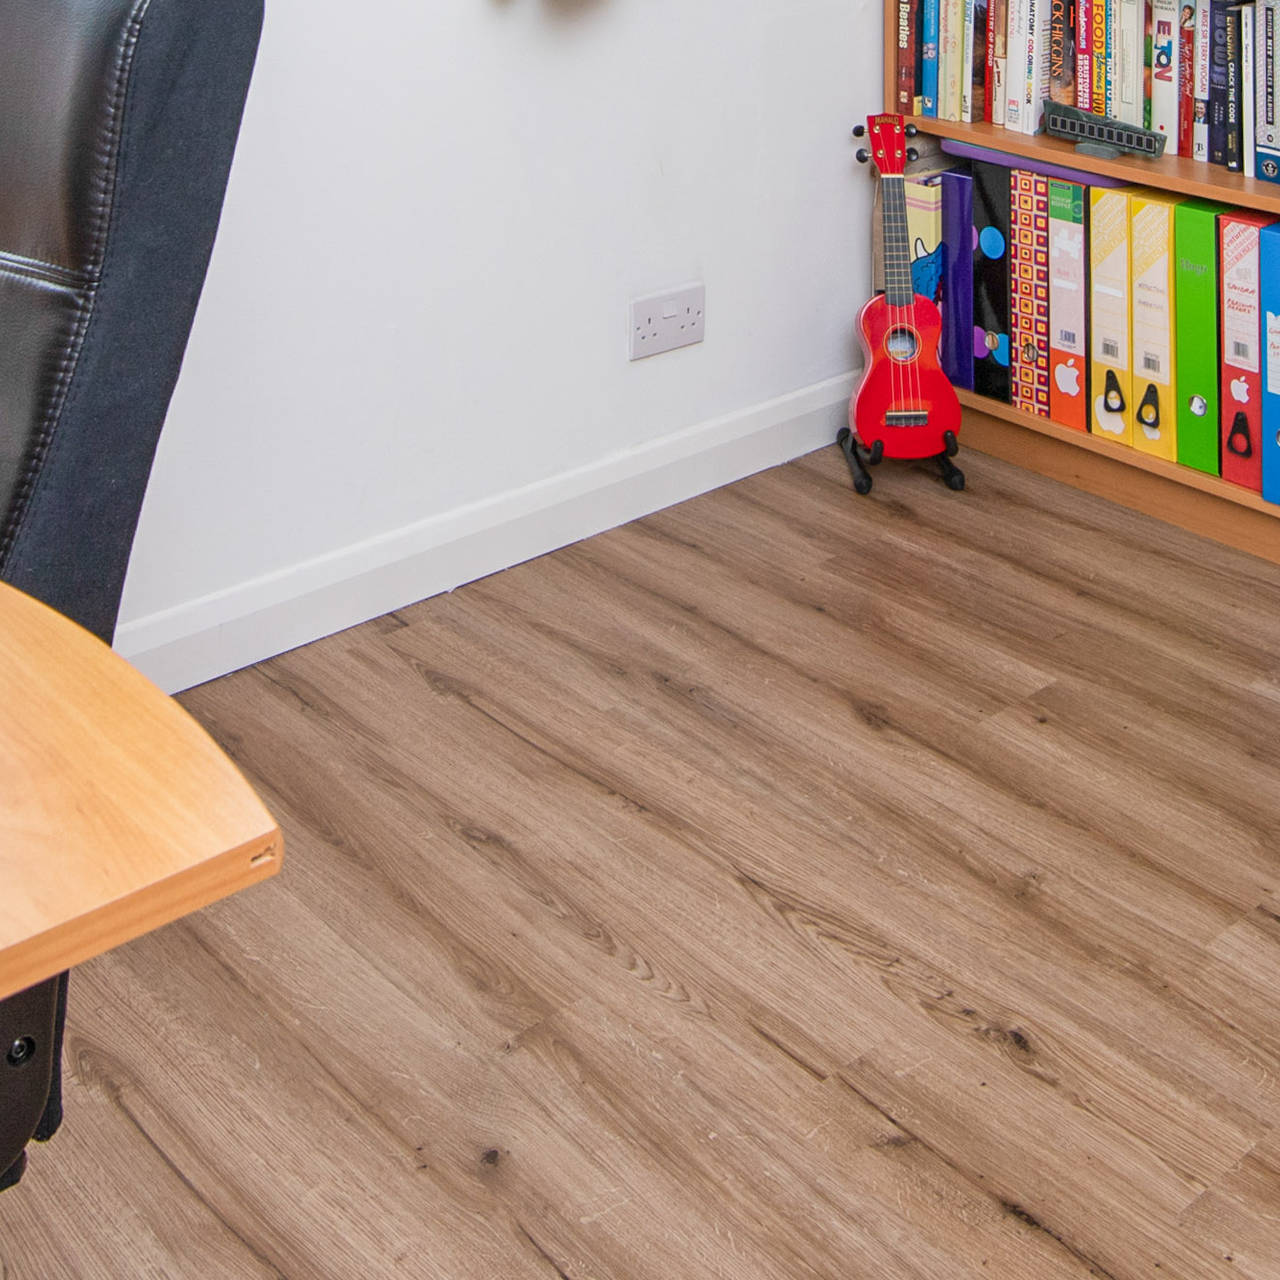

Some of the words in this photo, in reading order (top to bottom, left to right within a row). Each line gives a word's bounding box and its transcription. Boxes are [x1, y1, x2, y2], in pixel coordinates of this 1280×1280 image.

[898, 3, 911, 49] Beatles
[1093, 3, 1105, 48] FOOD
[1200, 9, 1209, 28] ARISE
[1200, 29, 1208, 39] SIR
[1226, 16, 1235, 61] ENIGMA
[1026, 38, 1036, 80] COLORING
[1051, 23, 1064, 77] HIGGINS
[1154, 20, 1173, 82] ELTON
[1200, 40, 1209, 62] TERRY
[1200, 63, 1209, 93] WOGAN
[1025, 82, 1034, 105] BOOK
[1228, 87, 1236, 101] THE
[1228, 102, 1236, 123] CODE
